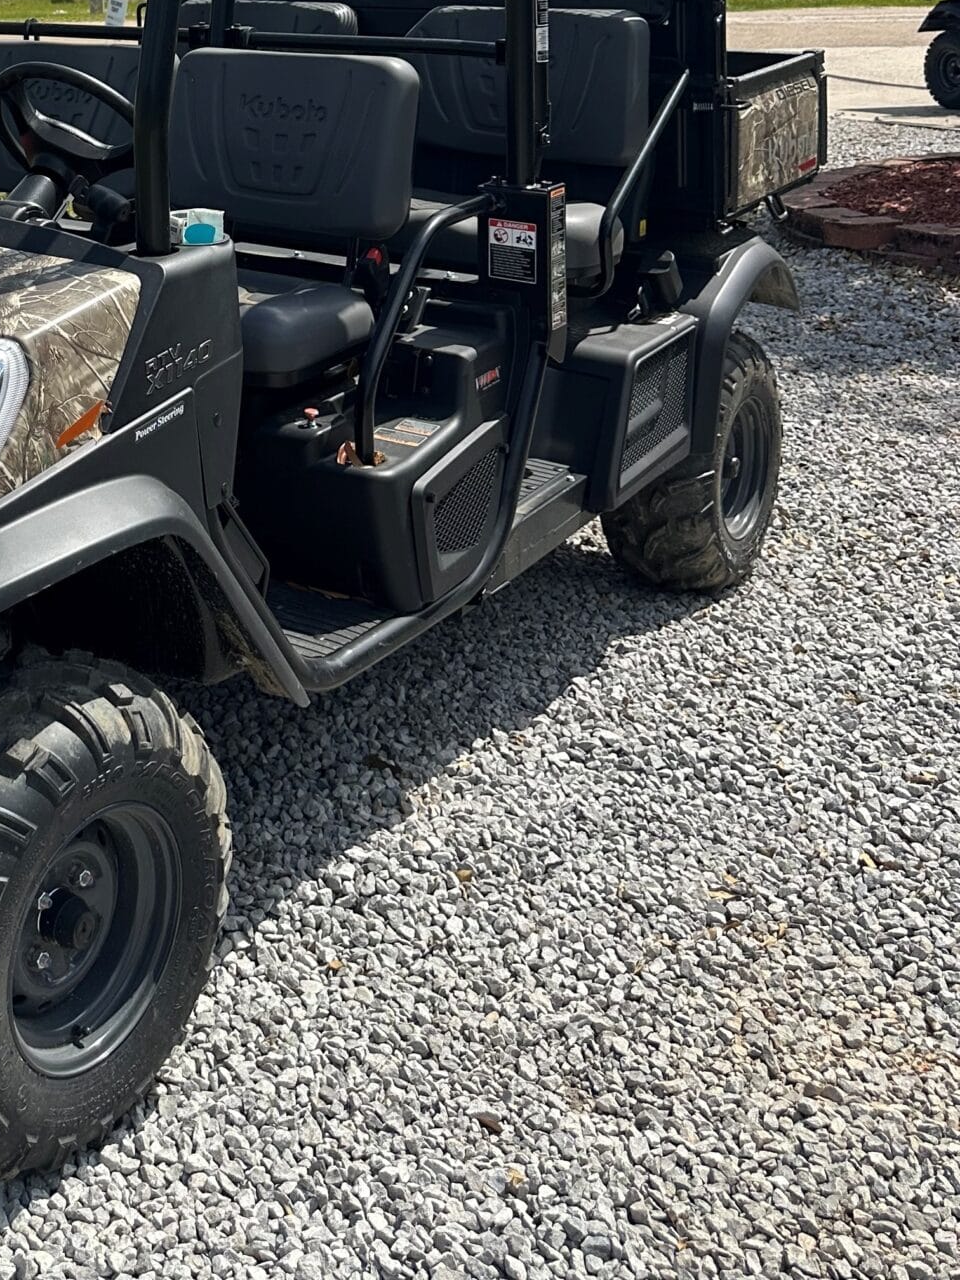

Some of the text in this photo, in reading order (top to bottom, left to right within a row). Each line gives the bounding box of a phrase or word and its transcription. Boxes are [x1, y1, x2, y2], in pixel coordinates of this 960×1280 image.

[776, 79, 817, 101] DIESEL
[240, 93, 329, 122] Kubota
[503, 221, 529, 231] DANGER
[145, 342, 181, 373] RTV
[146, 339, 214, 395] X1140
[135, 404, 184, 442] Power Steering
